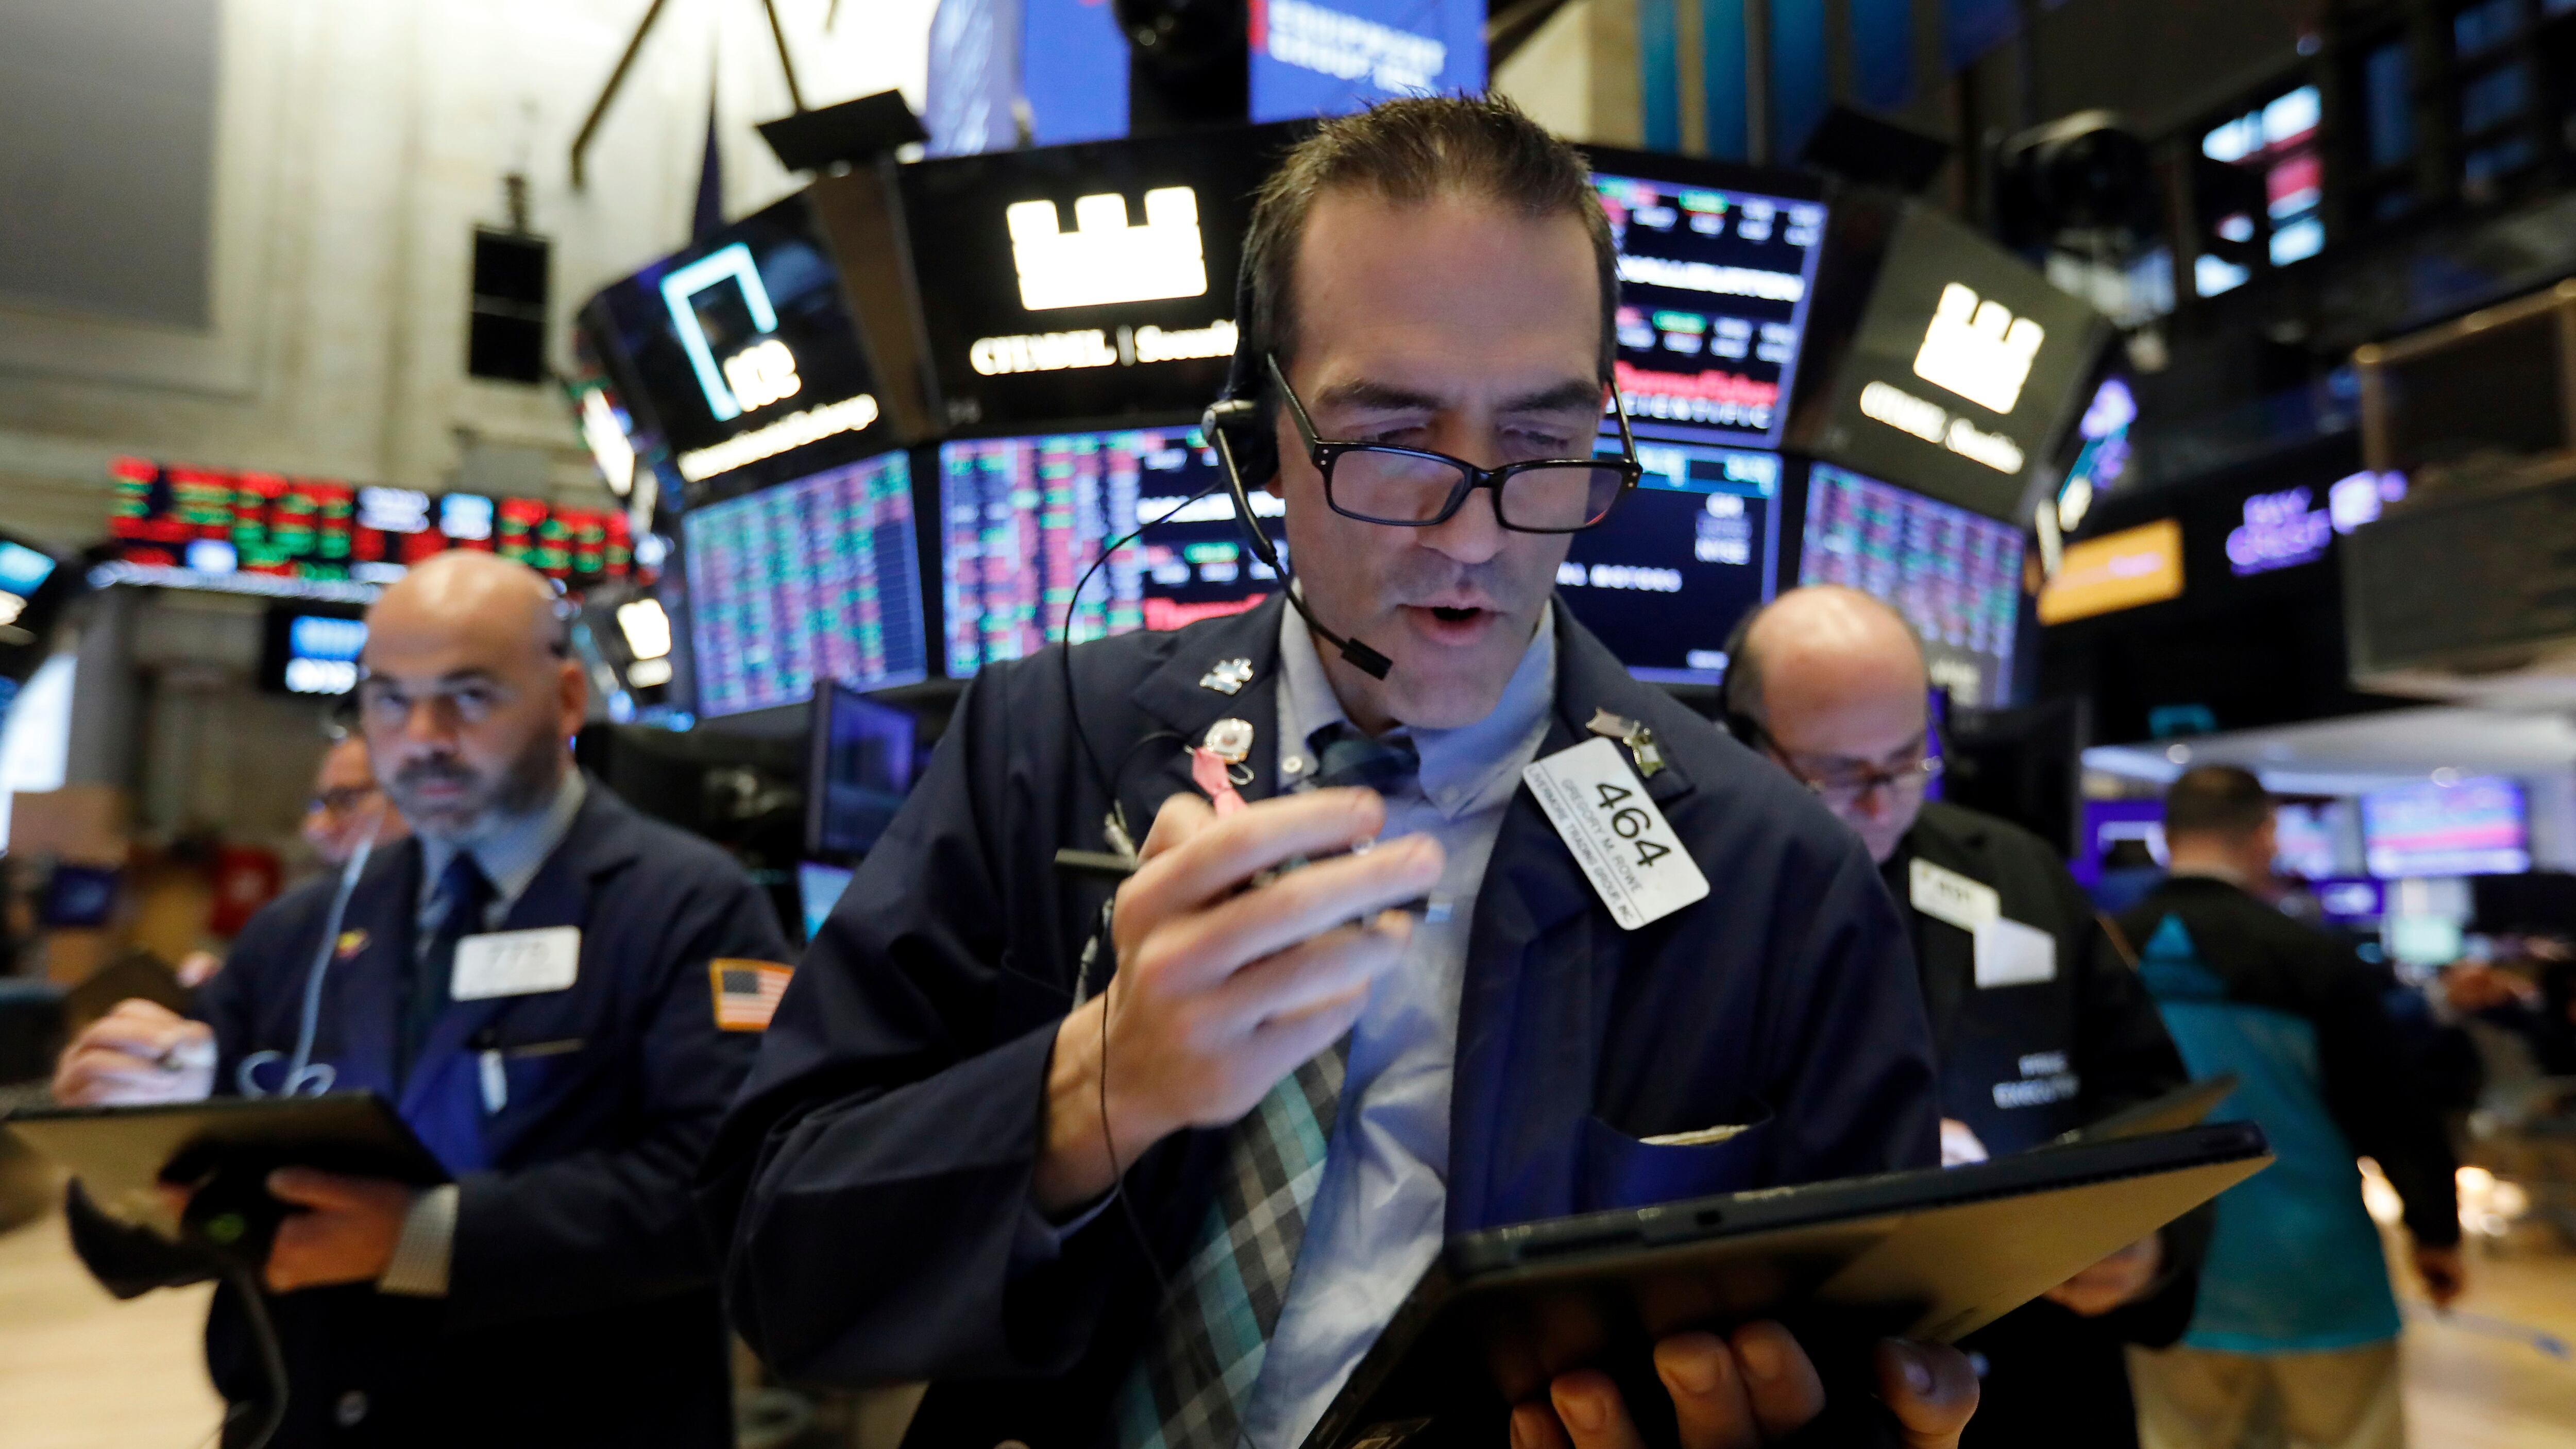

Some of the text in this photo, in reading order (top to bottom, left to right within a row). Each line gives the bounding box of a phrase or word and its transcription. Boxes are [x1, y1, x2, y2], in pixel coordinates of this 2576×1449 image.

[1561, 778, 1603, 836] GREGORY
[1614, 852, 1643, 893] ROWE
[1566, 822, 1597, 867] TRADING
[1595, 782, 1672, 867] 464
